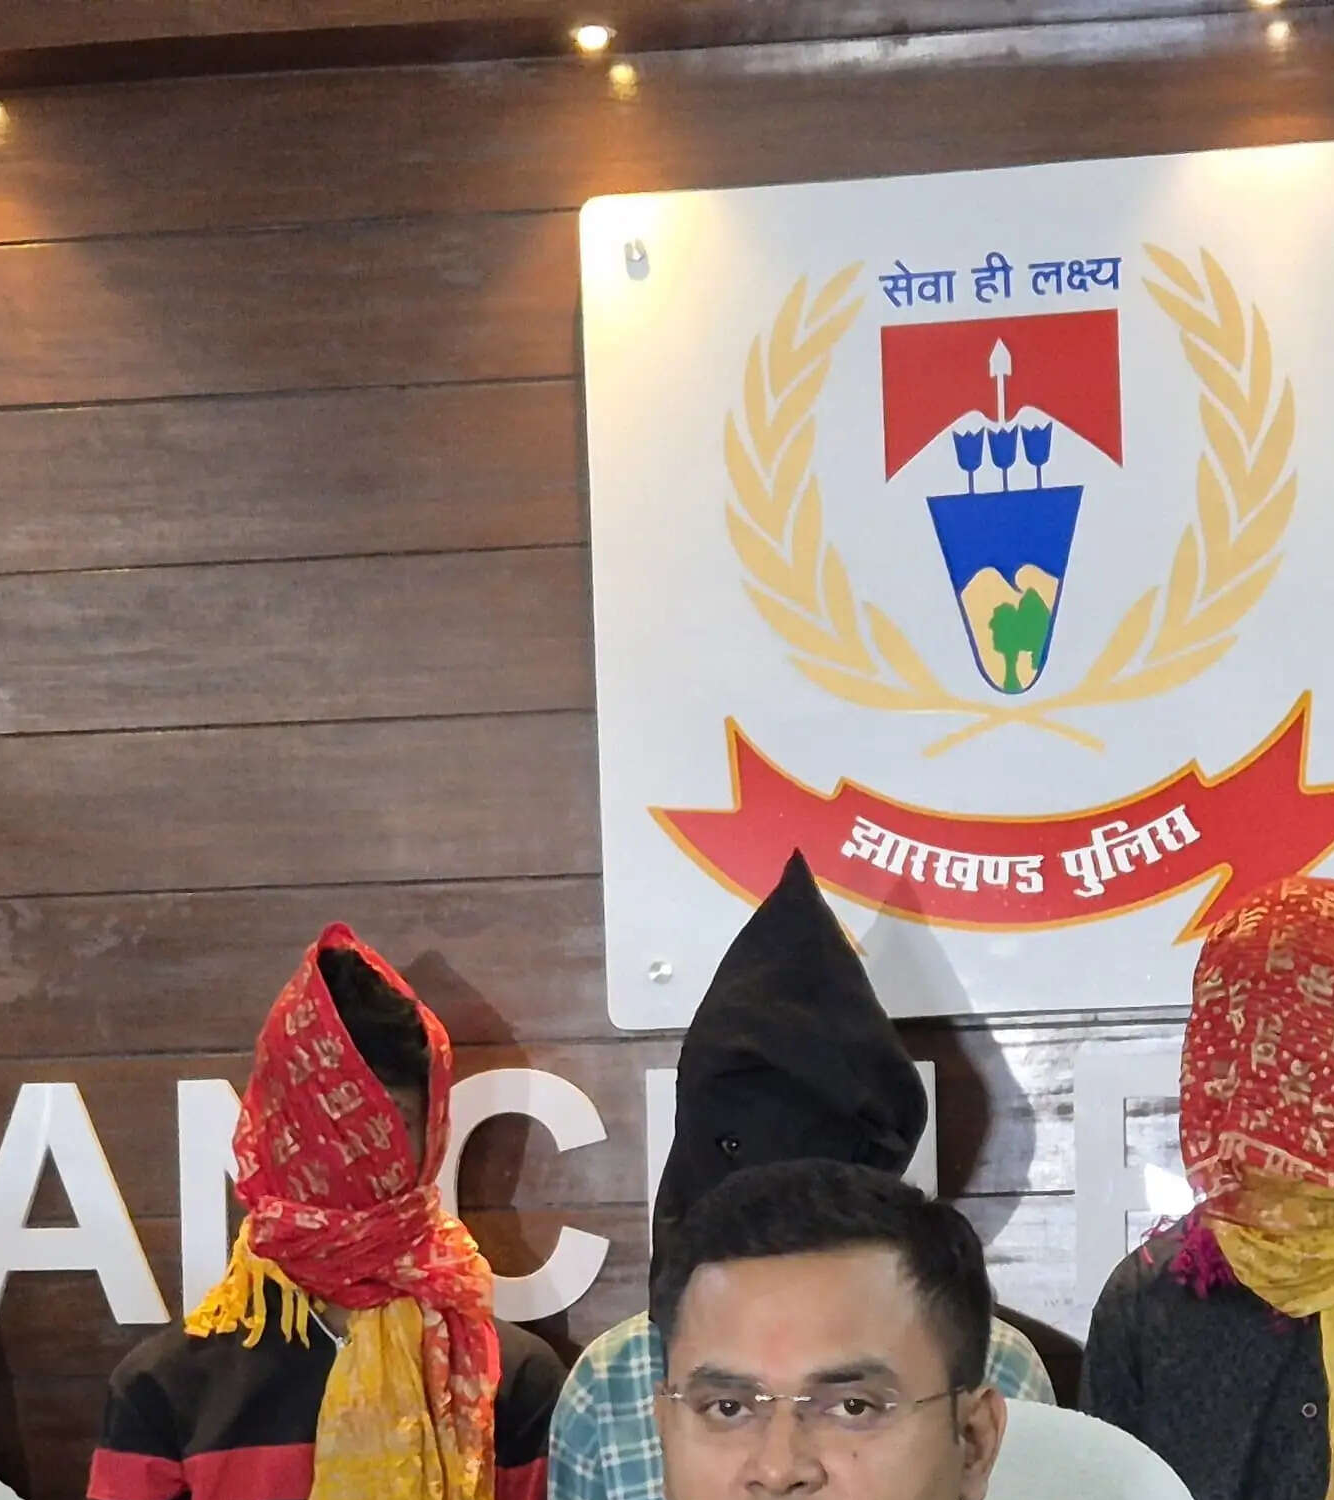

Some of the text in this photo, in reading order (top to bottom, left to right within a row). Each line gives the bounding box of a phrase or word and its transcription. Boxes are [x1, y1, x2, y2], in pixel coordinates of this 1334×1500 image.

[878, 251, 1123, 308] सेवा ही लक्ष्य
[840, 803, 1202, 898] झारखण्ड पुलिस
